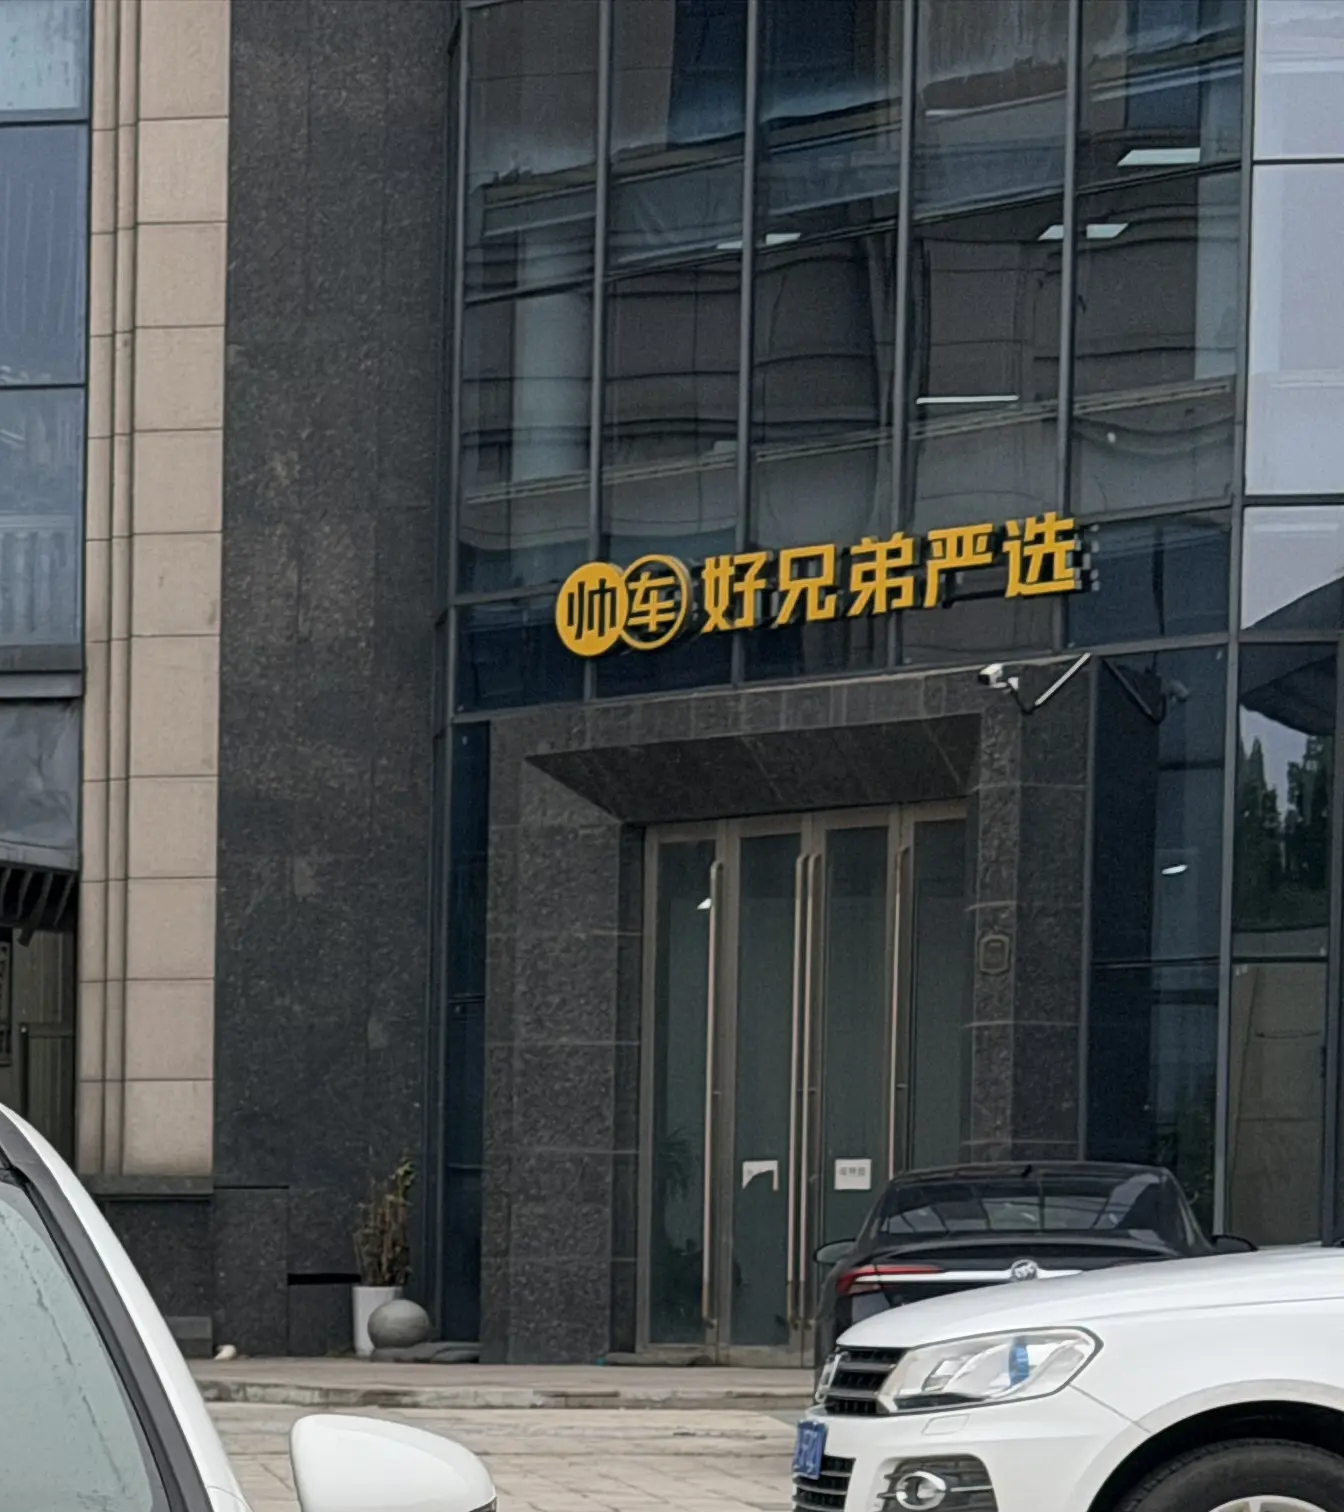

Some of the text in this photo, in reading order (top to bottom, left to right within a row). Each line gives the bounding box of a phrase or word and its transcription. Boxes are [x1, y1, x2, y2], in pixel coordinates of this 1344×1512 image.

[702, 512, 1077, 632] 好兄弟严选
